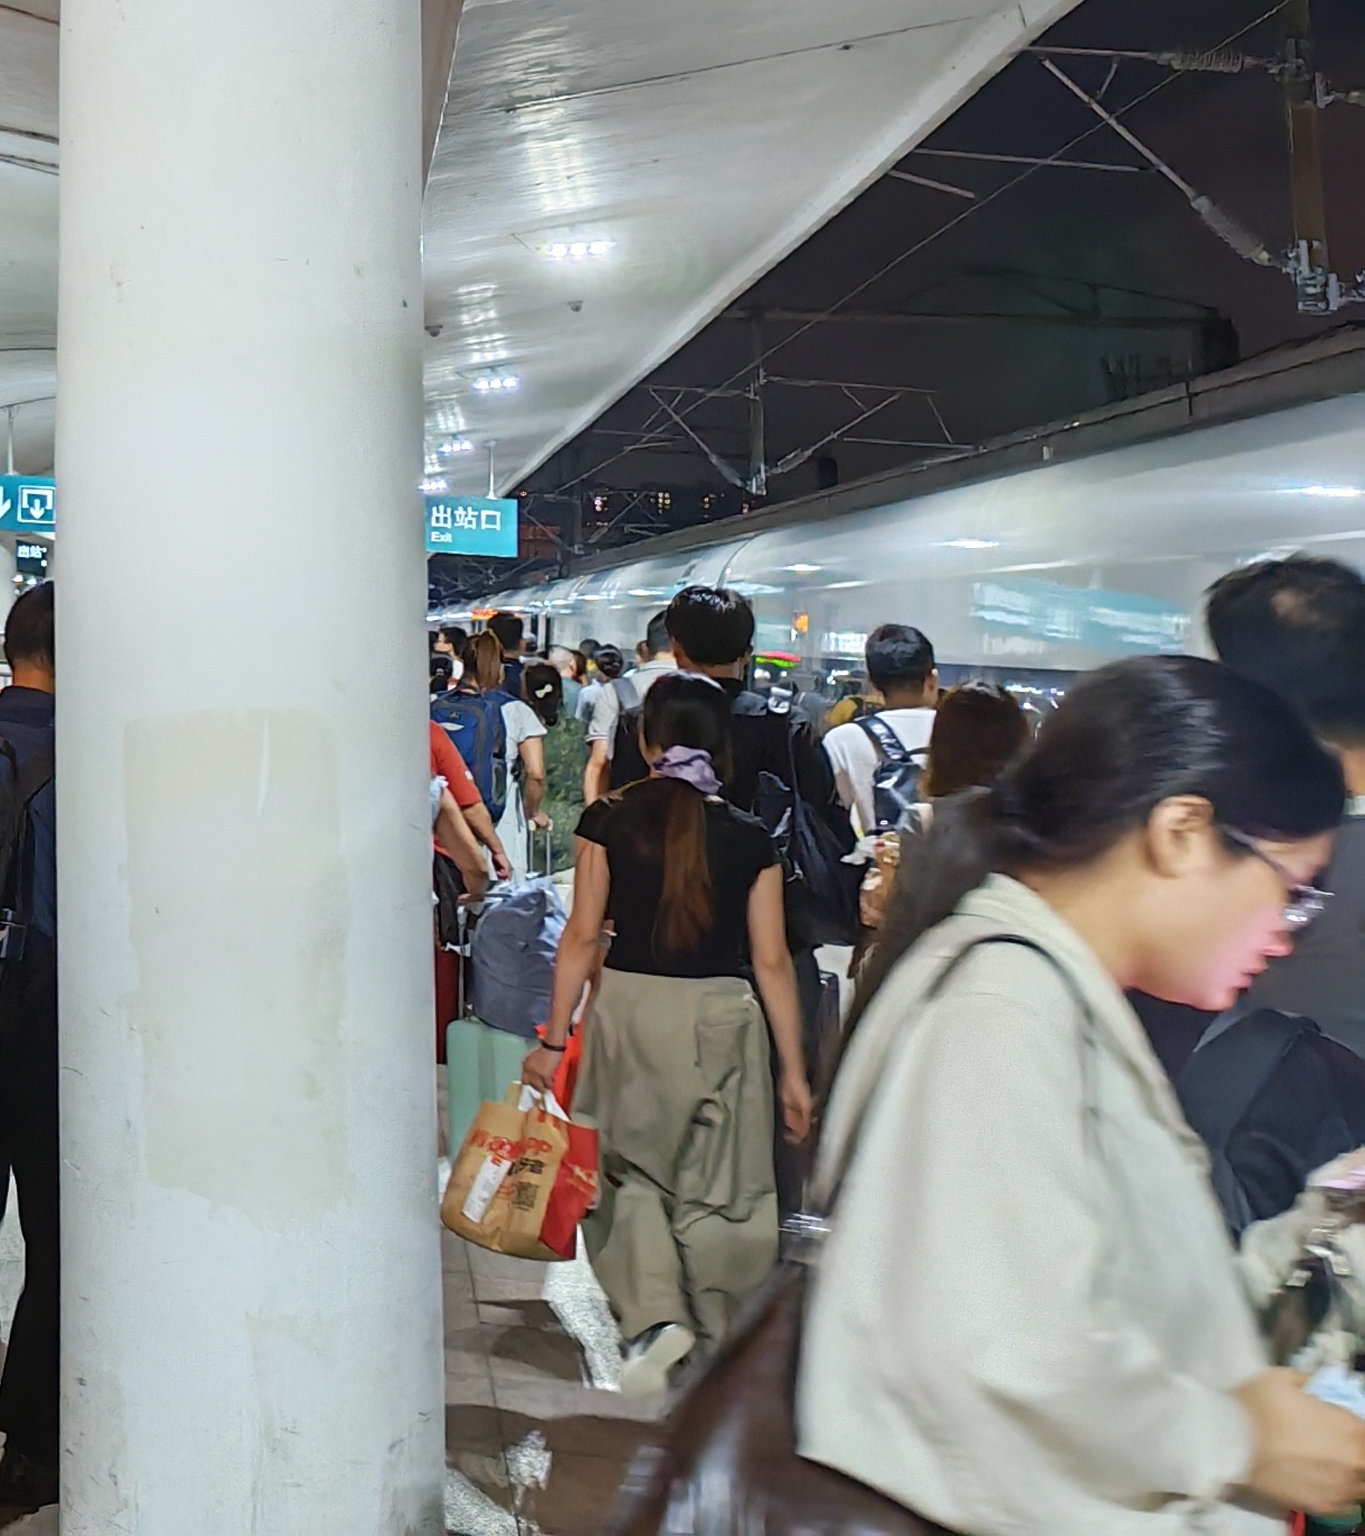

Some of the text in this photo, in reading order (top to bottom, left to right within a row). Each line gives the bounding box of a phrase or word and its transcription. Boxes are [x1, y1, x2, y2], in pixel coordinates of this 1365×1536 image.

[430, 505, 502, 531] 出站口
[430, 531, 453, 543] Exit
